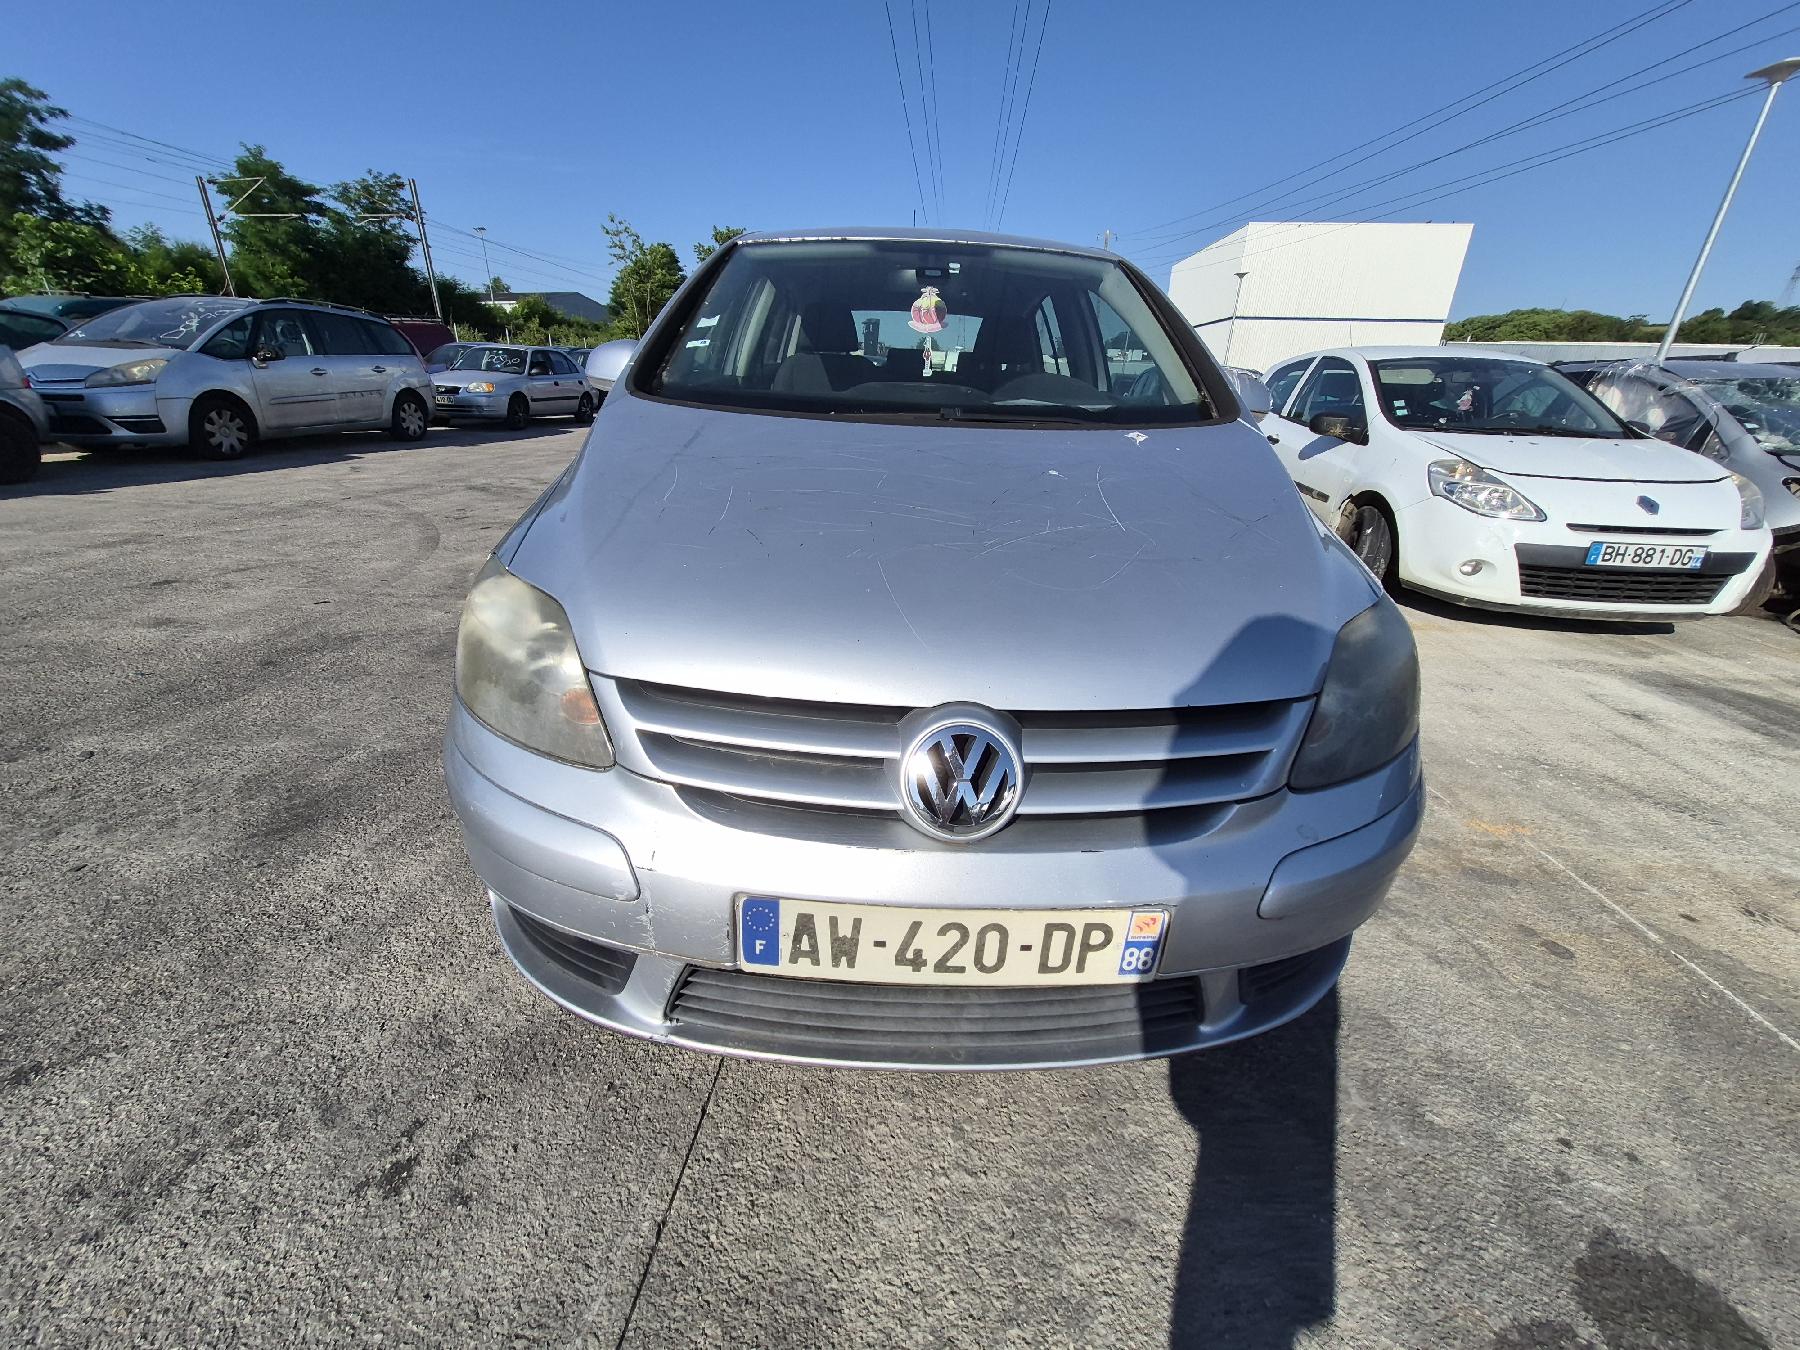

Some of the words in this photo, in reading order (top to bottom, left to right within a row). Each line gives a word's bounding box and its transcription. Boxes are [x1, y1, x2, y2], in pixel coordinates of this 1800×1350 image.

[1601, 545, 1694, 566] BH-881-DG
[755, 940, 766, 955] F
[788, 912, 1114, 975] AW-420-DP
[1122, 947, 1154, 971] 88
